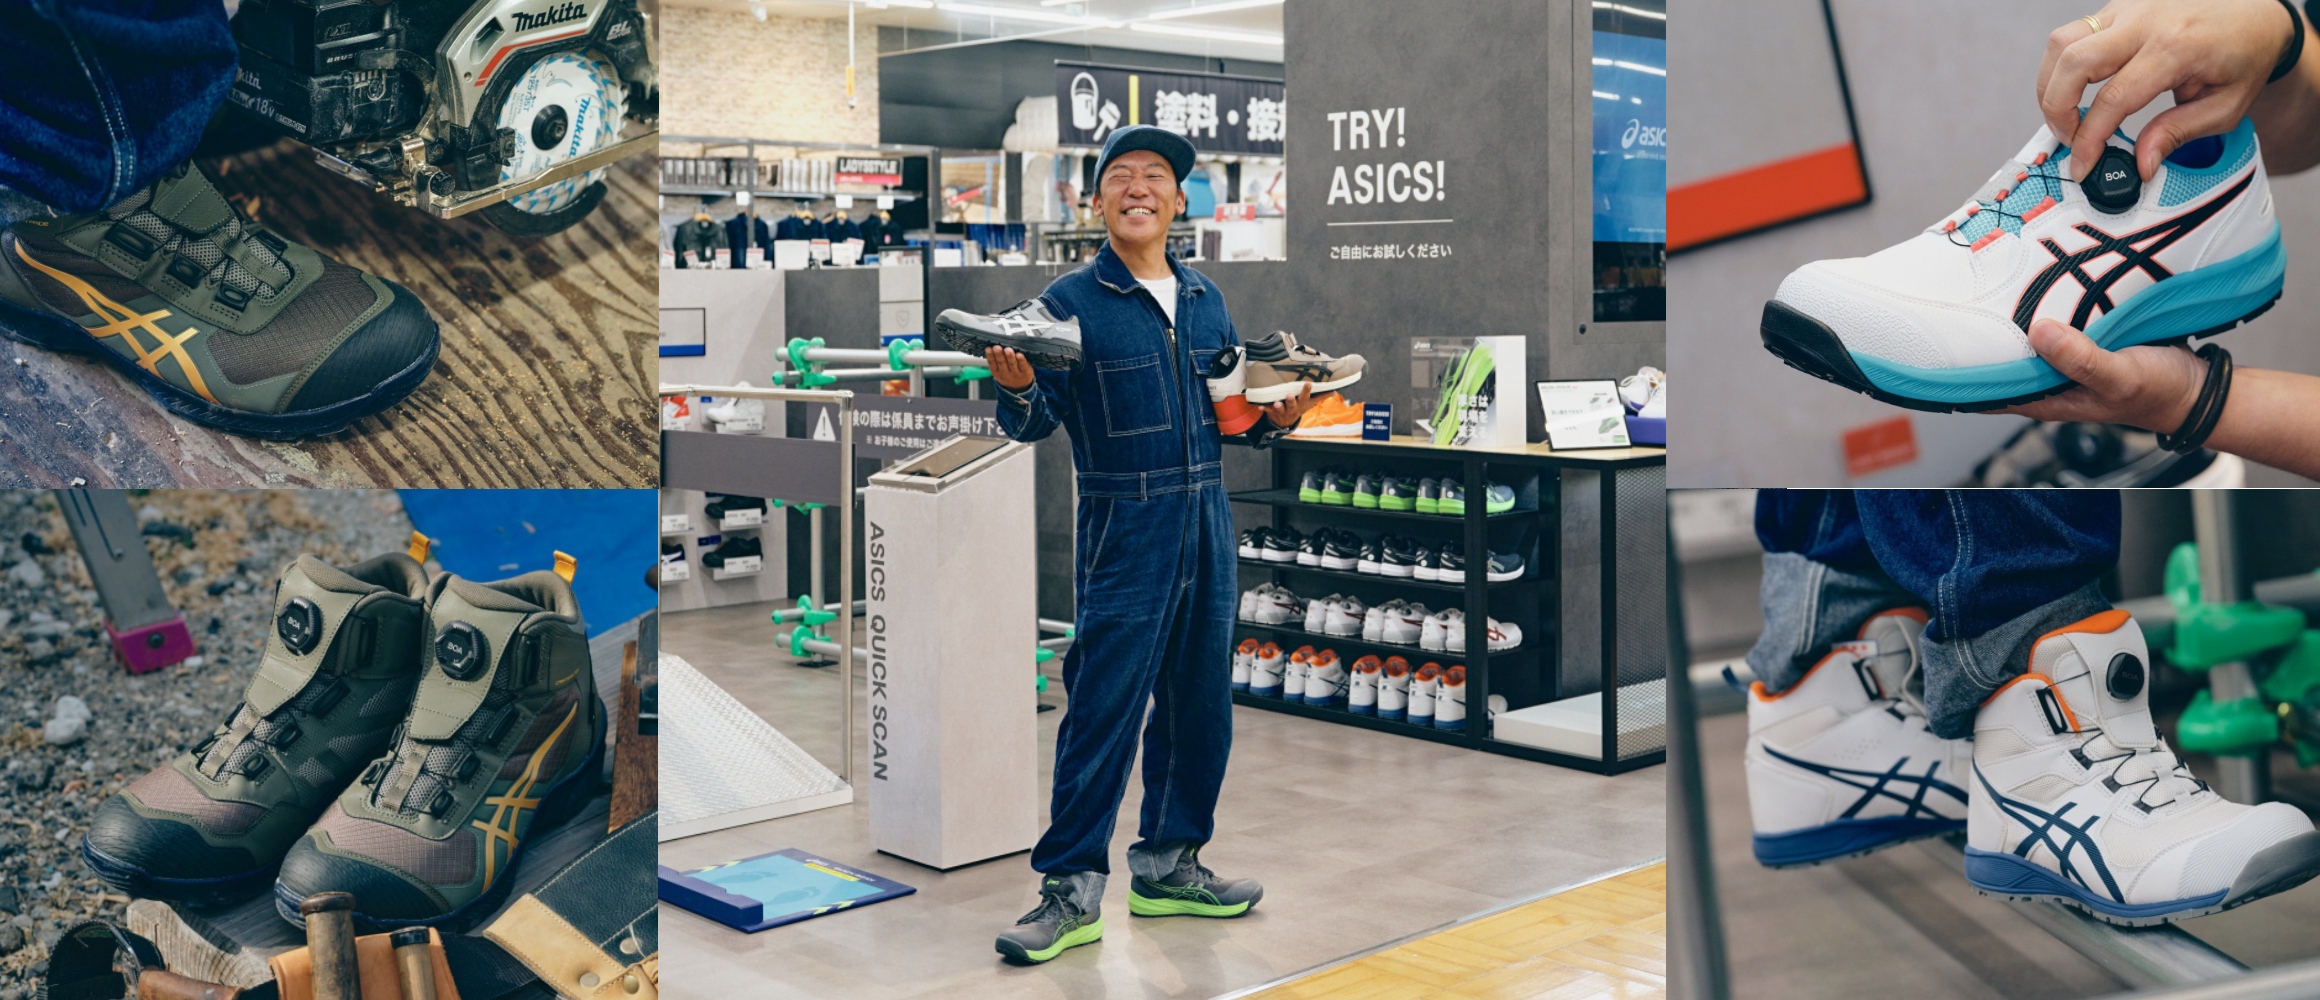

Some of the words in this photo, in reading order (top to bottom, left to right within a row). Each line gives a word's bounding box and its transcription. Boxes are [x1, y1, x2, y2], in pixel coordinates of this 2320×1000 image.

[1327, 107, 1406, 151] TRY!
[1327, 160, 1446, 205] ASICS!
[2105, 170, 2127, 181] BOA
[1330, 243, 1453, 260] ご自由にお試しください
[870, 521, 886, 602] ASICS
[287, 616, 300, 629] BOA
[447, 642, 463, 654] BOA
[870, 614, 888, 701] QUICK
[872, 704, 889, 781] SCAN
